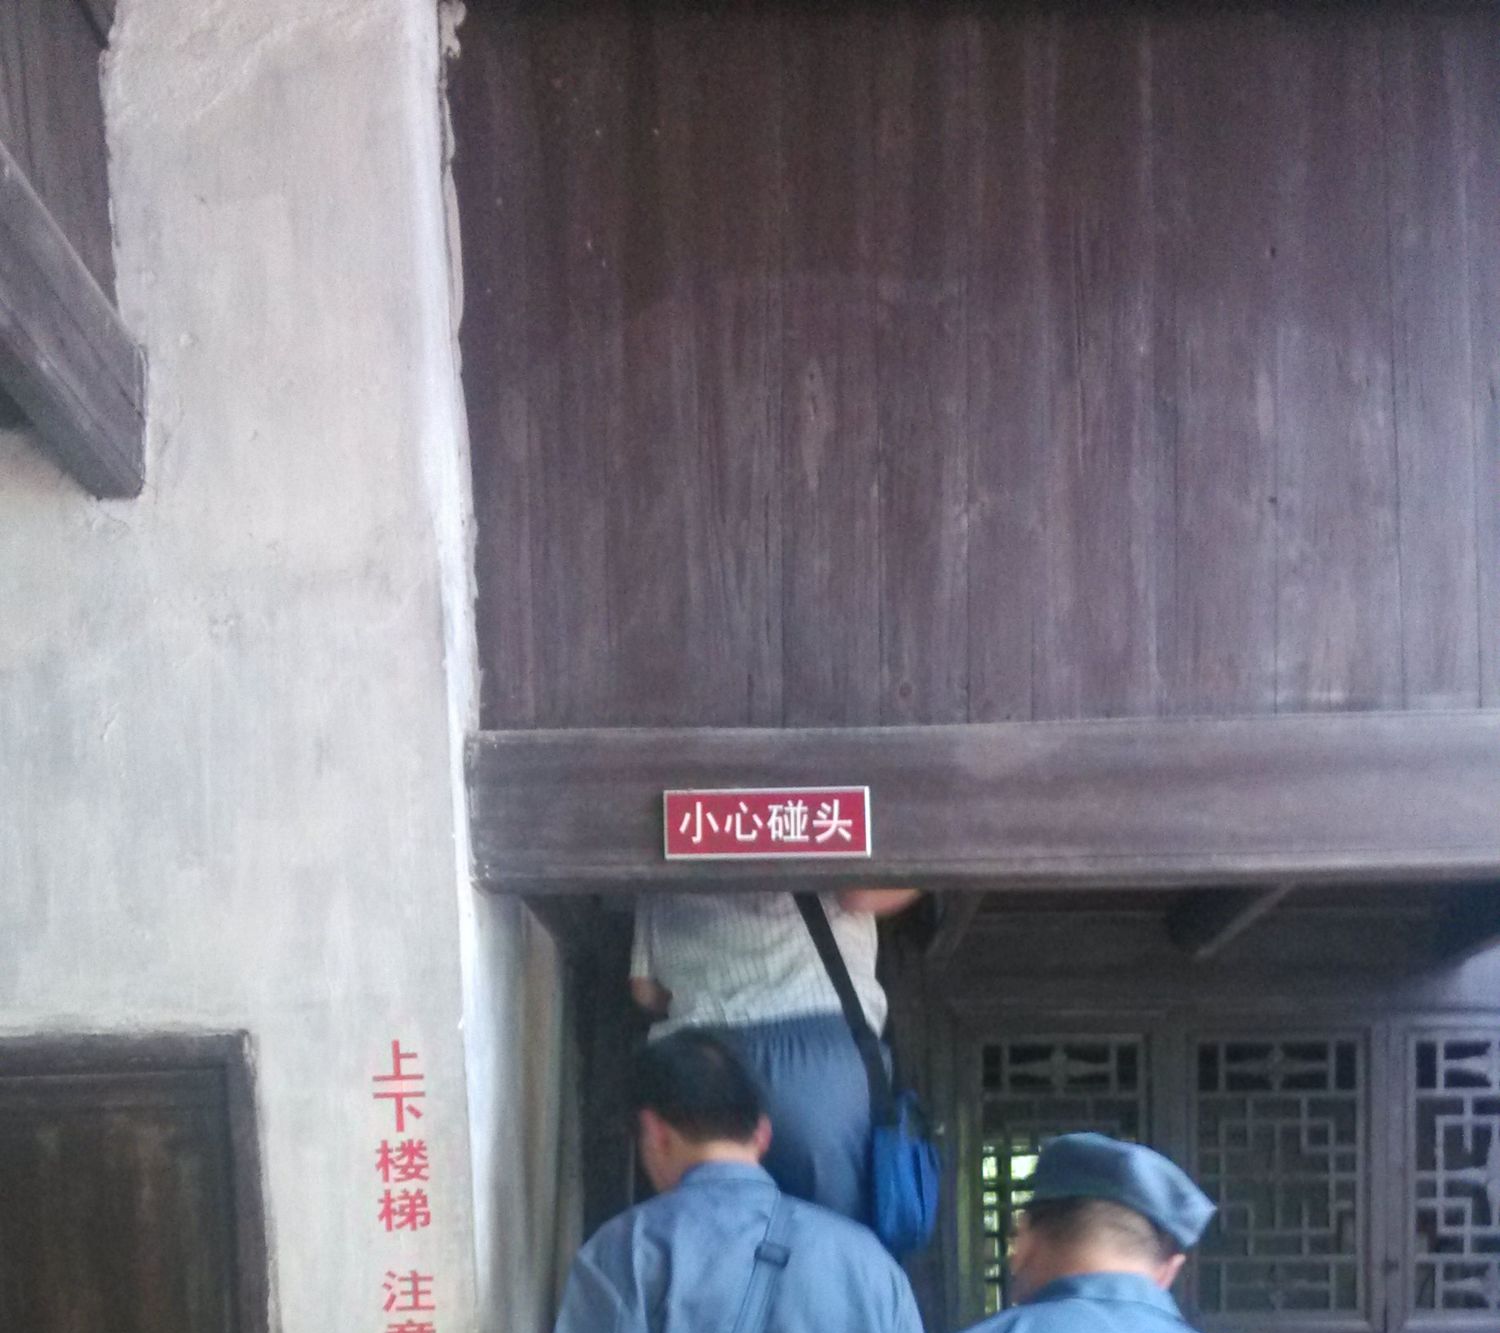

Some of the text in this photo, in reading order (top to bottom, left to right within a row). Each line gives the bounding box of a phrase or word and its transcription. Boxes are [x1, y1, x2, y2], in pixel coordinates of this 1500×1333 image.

[679, 799, 853, 844] 小心碰头
[372, 1039, 431, 1232] 上下楼梯
